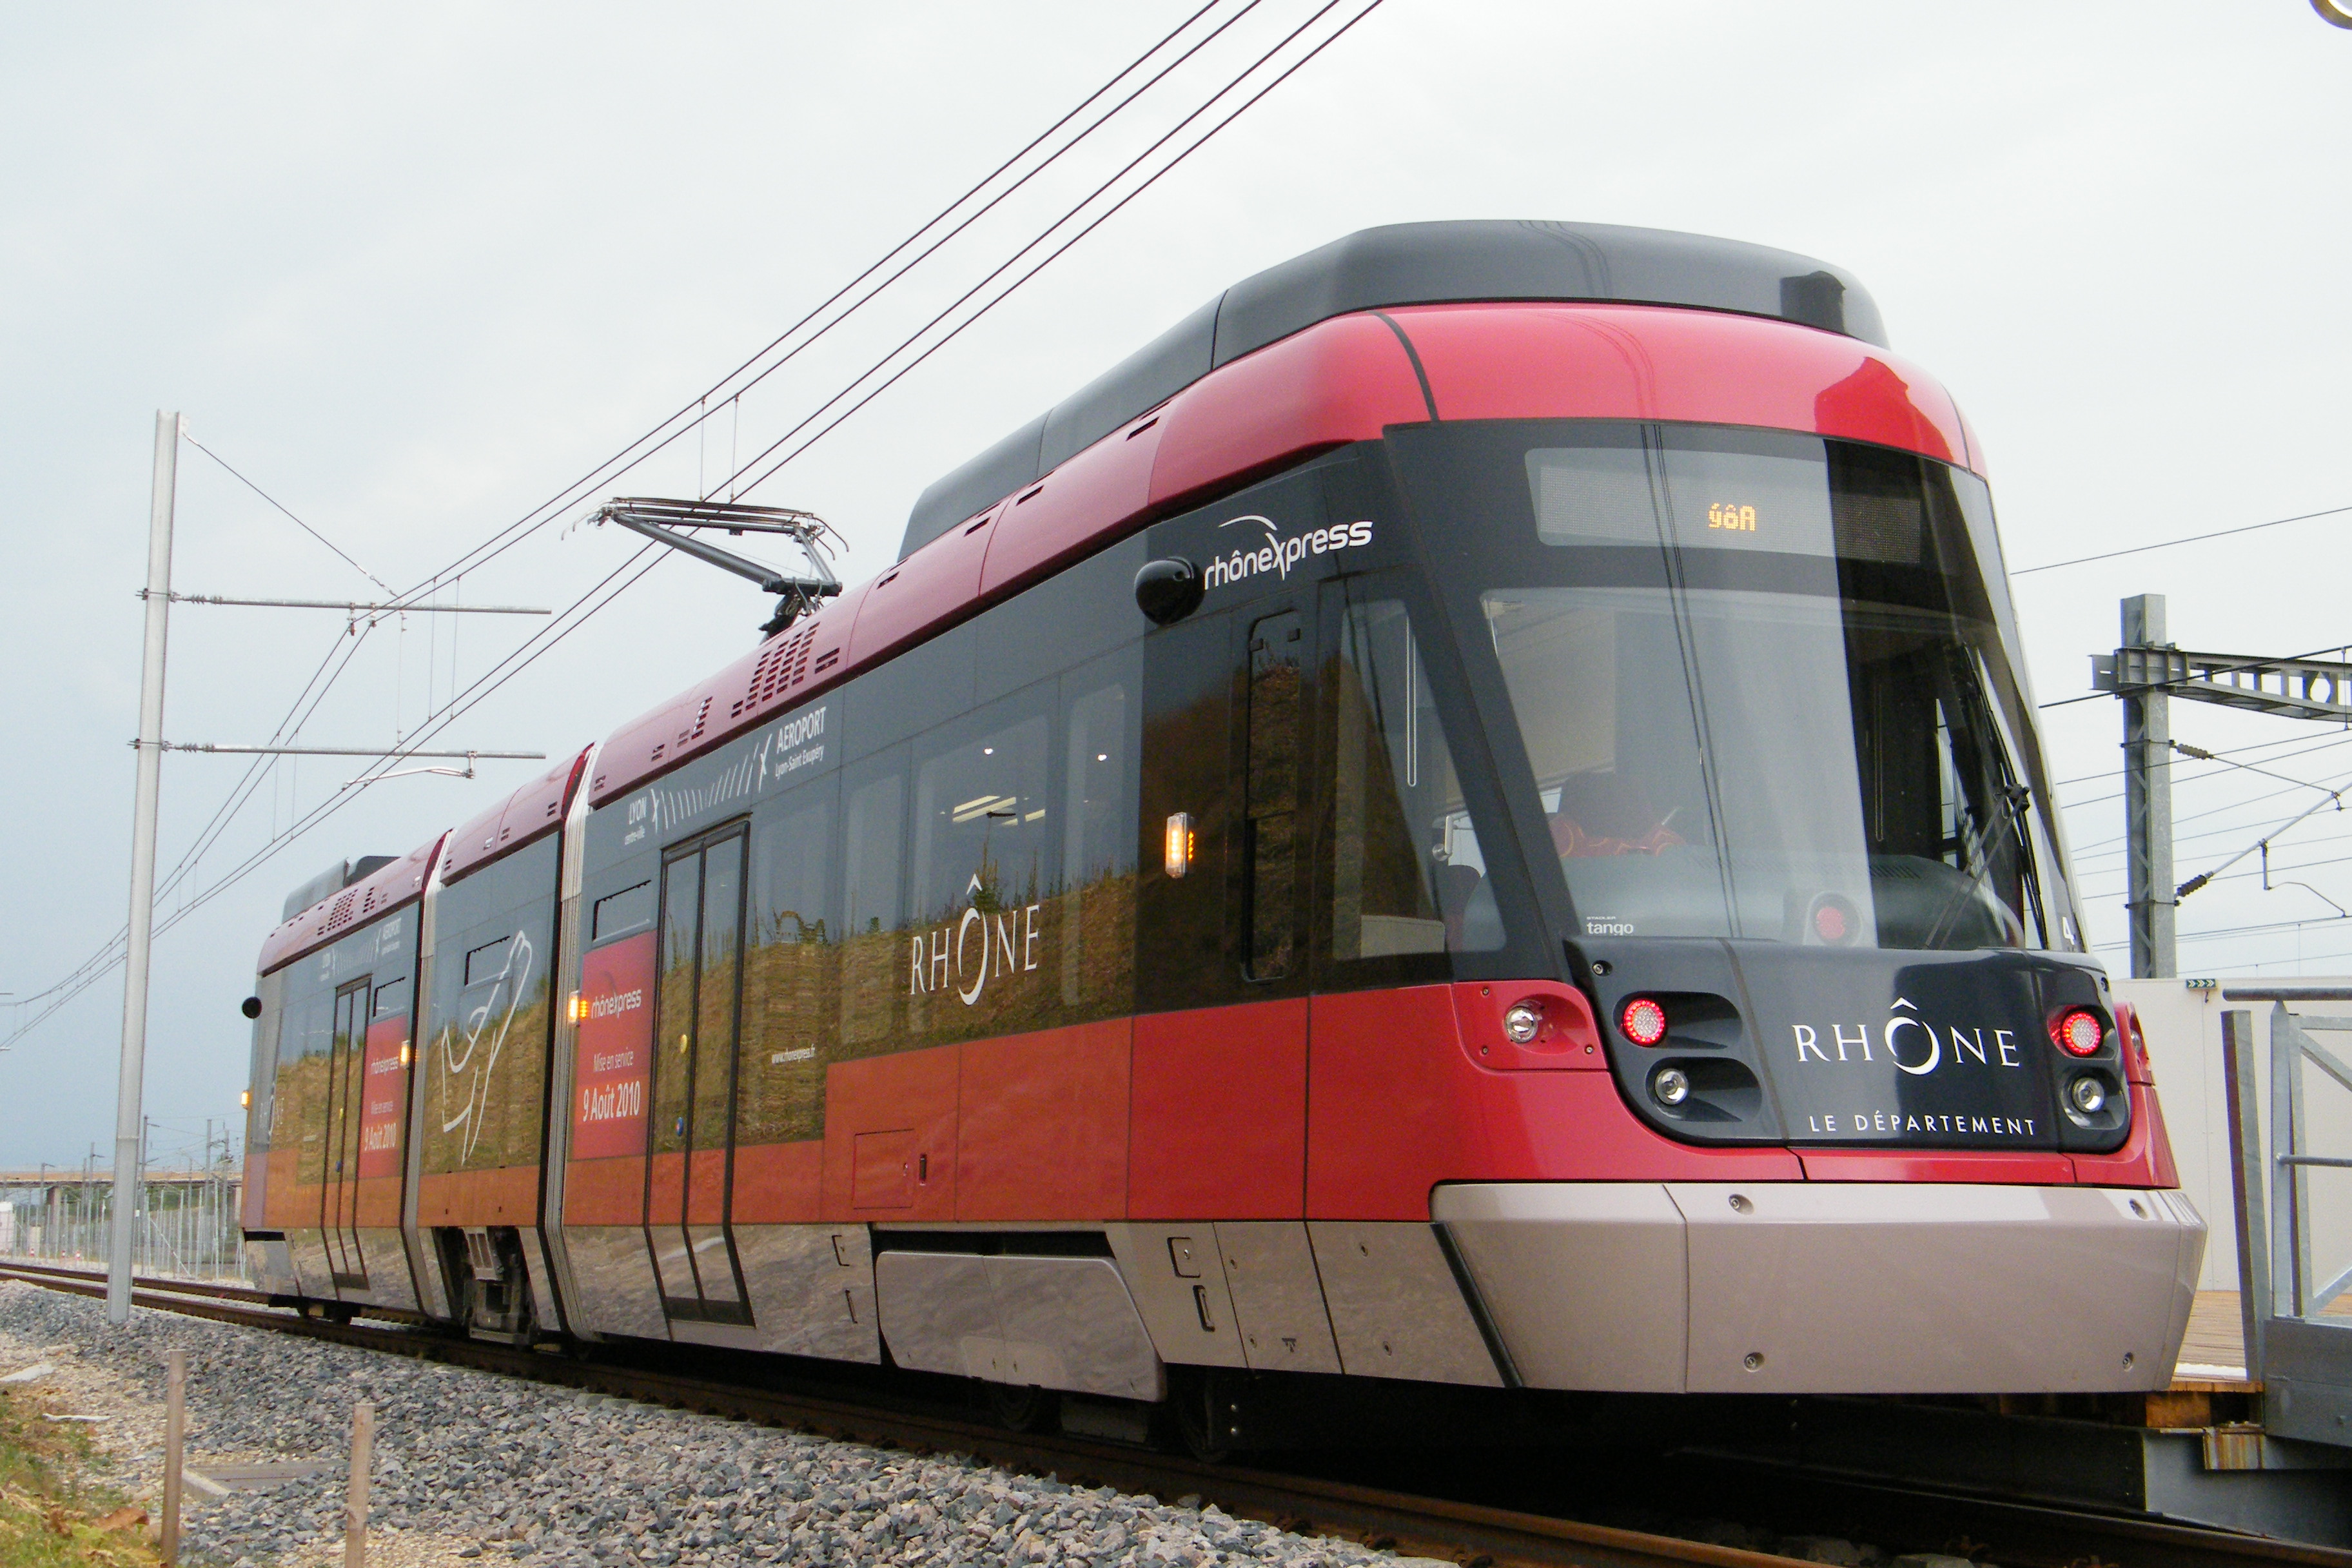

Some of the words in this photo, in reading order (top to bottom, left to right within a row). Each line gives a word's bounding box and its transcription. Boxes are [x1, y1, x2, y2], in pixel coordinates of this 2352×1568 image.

[1204, 521, 1373, 590] rhônexpress
[776, 707, 827, 754] AEROPORT
[629, 796, 647, 825] LYON
[910, 874, 1039, 1005] RHÔNE
[1587, 922, 1634, 936] tango
[591, 989, 642, 1019] rhônexpress
[1792, 997, 2020, 1075] RHÔNE
[593, 1052, 605, 1073] Mise
[607, 1054, 614, 1070] en
[614, 1047, 634, 1069] service
[583, 1089, 589, 1122] 9
[590, 1084, 615, 1121] Août
[616, 1081, 640, 1117] 2010
[1808, 1114, 1836, 1132] LE
[1854, 1110, 2035, 1137] DÉPARTEMENT
